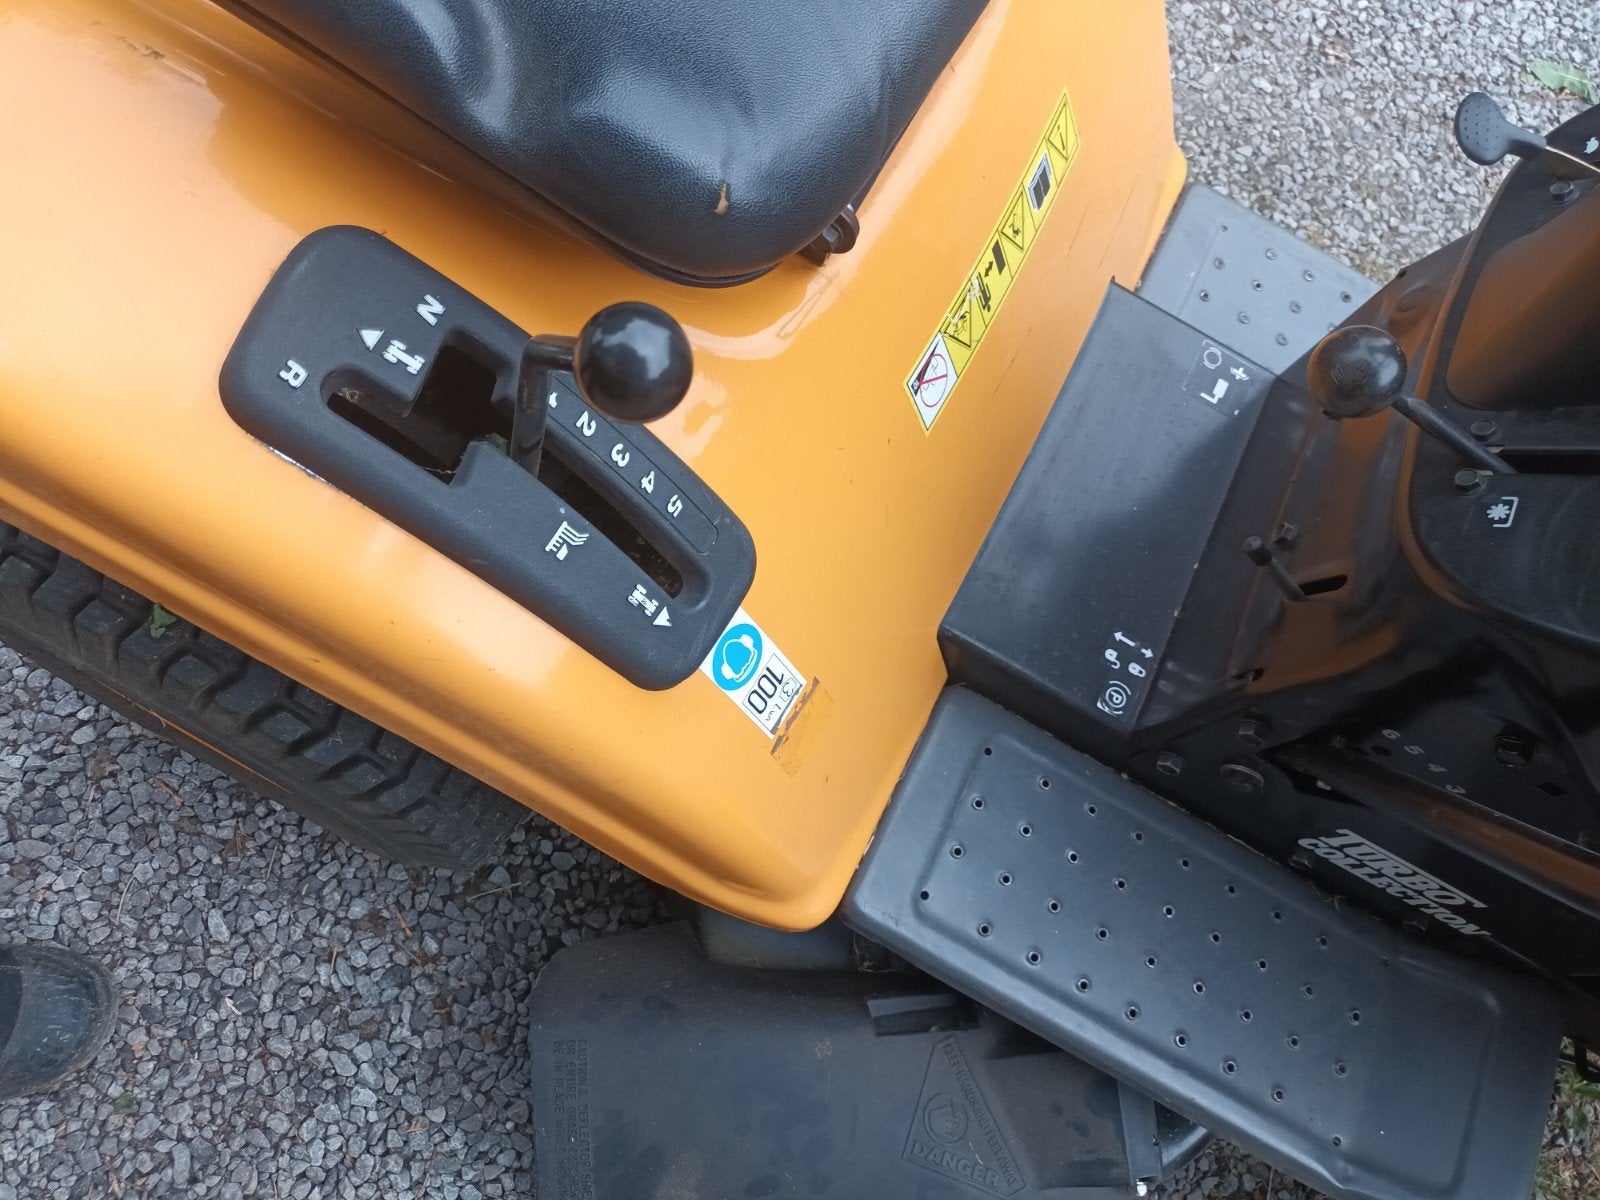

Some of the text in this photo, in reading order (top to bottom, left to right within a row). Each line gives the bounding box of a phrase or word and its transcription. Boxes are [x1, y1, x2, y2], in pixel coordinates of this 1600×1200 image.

[415, 294, 446, 326] N
[279, 359, 309, 389] R
[576, 411, 596, 437] 2
[611, 443, 630, 467] 3
[641, 470, 655, 494] 4
[667, 494, 683, 518] 5
[747, 666, 785, 715] 100
[1381, 728, 1401, 740] 6
[1403, 744, 1426, 755] 5
[1318, 828, 1488, 909] TURBO
[1298, 838, 1491, 937] COLLECTION
[577, 1038, 588, 1087] CAUTION
[565, 1062, 577, 1101] ENTIRE
[911, 1139, 999, 1187] DANGER
